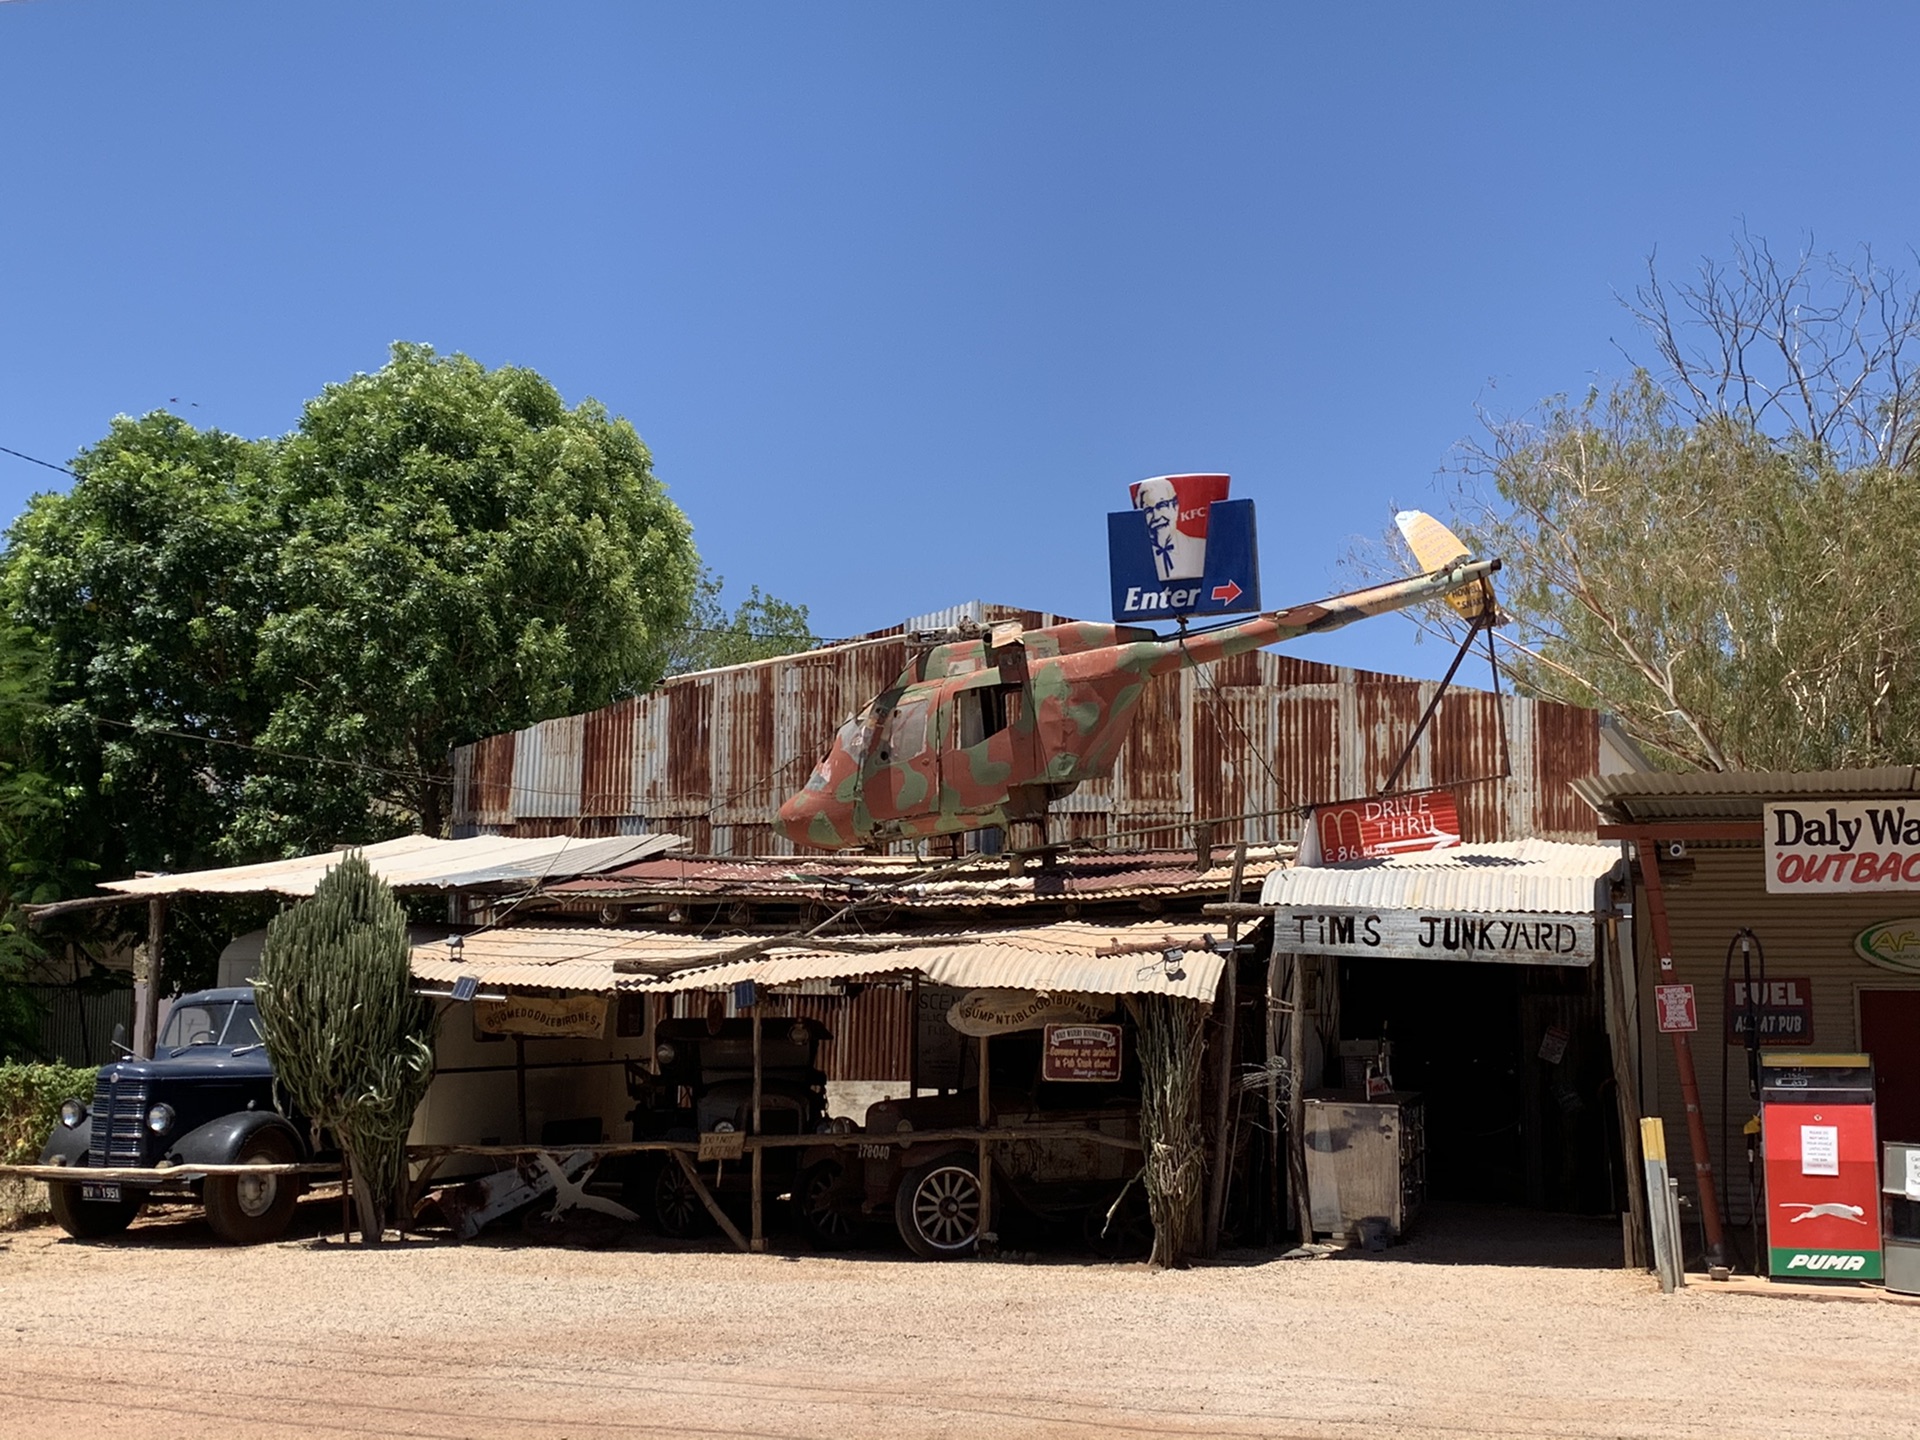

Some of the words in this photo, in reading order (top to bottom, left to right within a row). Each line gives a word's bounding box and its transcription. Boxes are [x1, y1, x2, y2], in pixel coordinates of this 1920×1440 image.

[1180, 507, 1206, 521] KFC
[1124, 586, 1202, 612] Enter
[1365, 794, 1431, 822] DRIVE
[1374, 814, 1435, 838] THRU
[1773, 808, 1862, 852] Daly
[1325, 845, 1359, 862] 286
[1418, 917, 1577, 954] JUNKYARD
[1734, 982, 1804, 1006] FUEL
[1760, 1016, 1776, 1033] AT
[1778, 1016, 1803, 1033] PUB
[102, 1187, 119, 1199] 1951
[1787, 1254, 1865, 1271] PUMA
